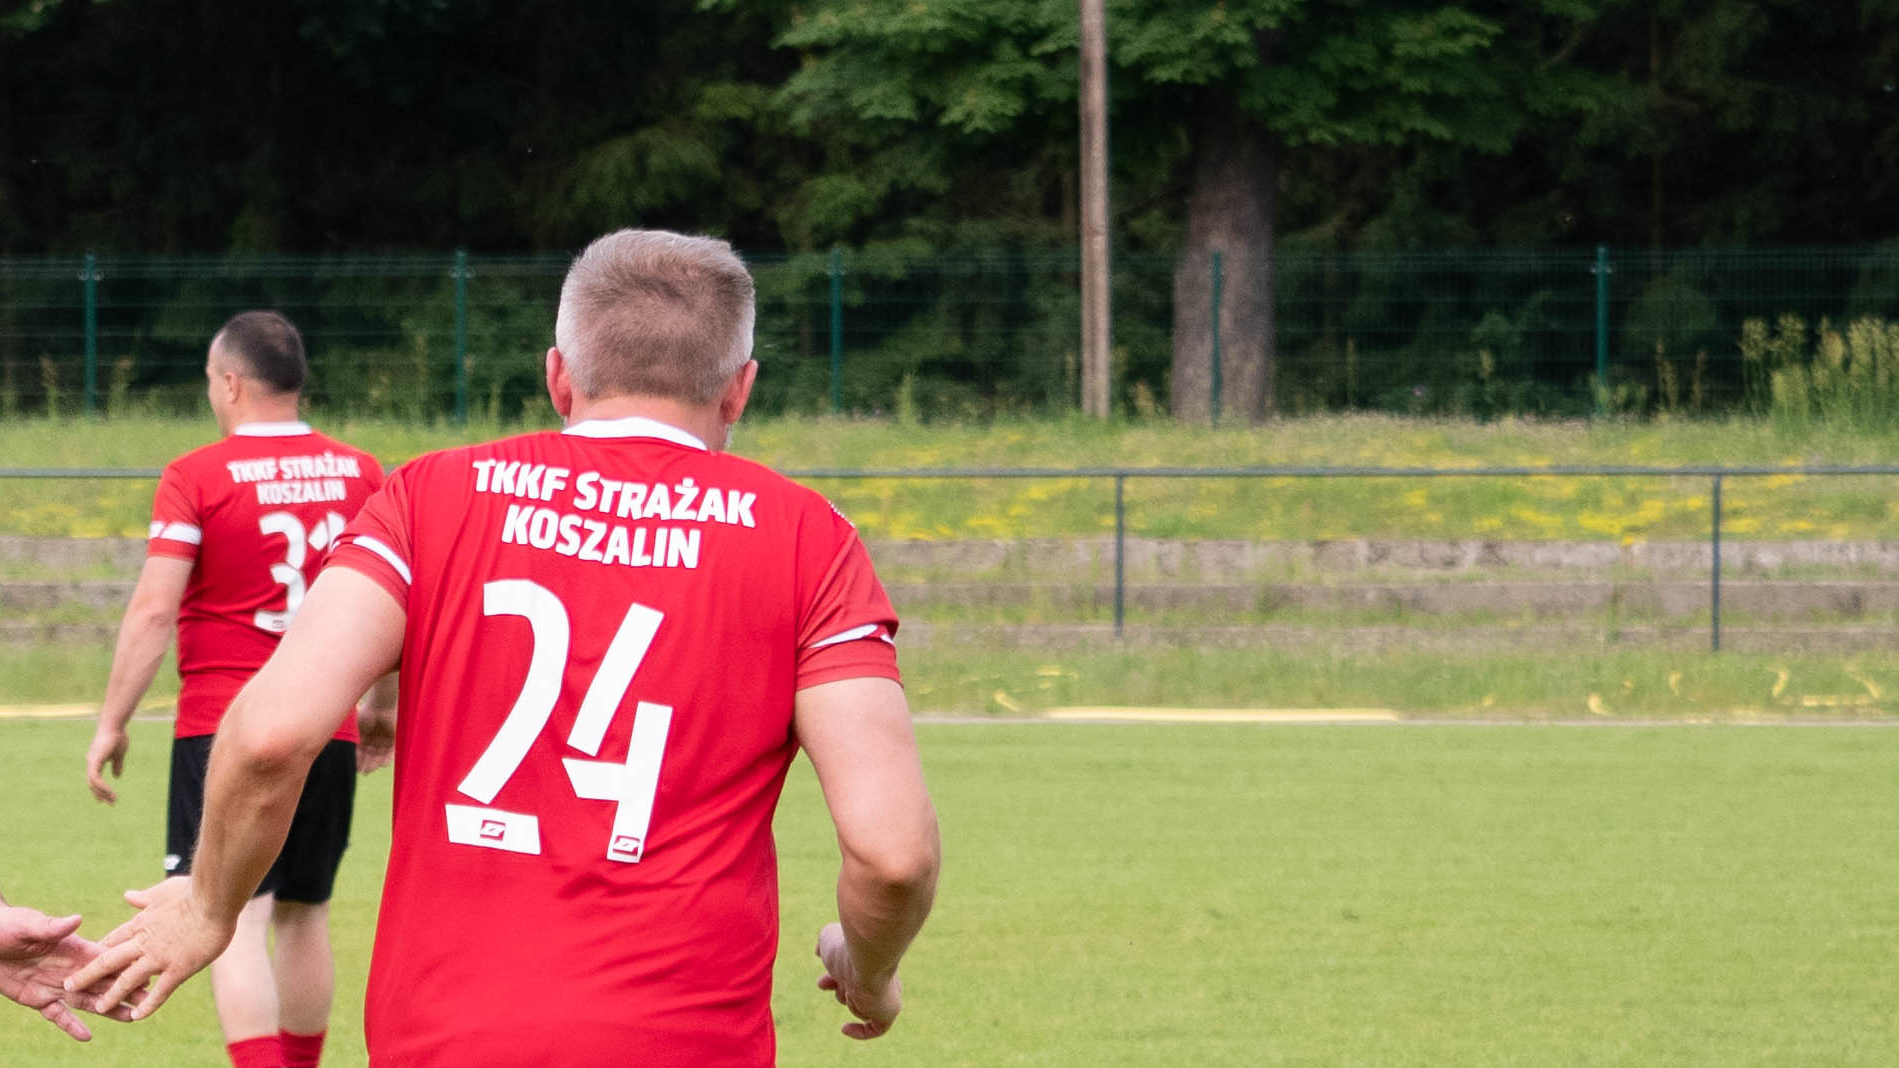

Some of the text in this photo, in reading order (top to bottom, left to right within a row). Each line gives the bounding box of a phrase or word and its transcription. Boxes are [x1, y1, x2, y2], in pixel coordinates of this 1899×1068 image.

[227, 458, 277, 483] TKKF
[255, 479, 347, 505] KOSZALIN
[472, 458, 757, 528] TKKF STRAŻAK
[501, 504, 701, 569] KOSZALIN
[445, 578, 673, 863] 24
